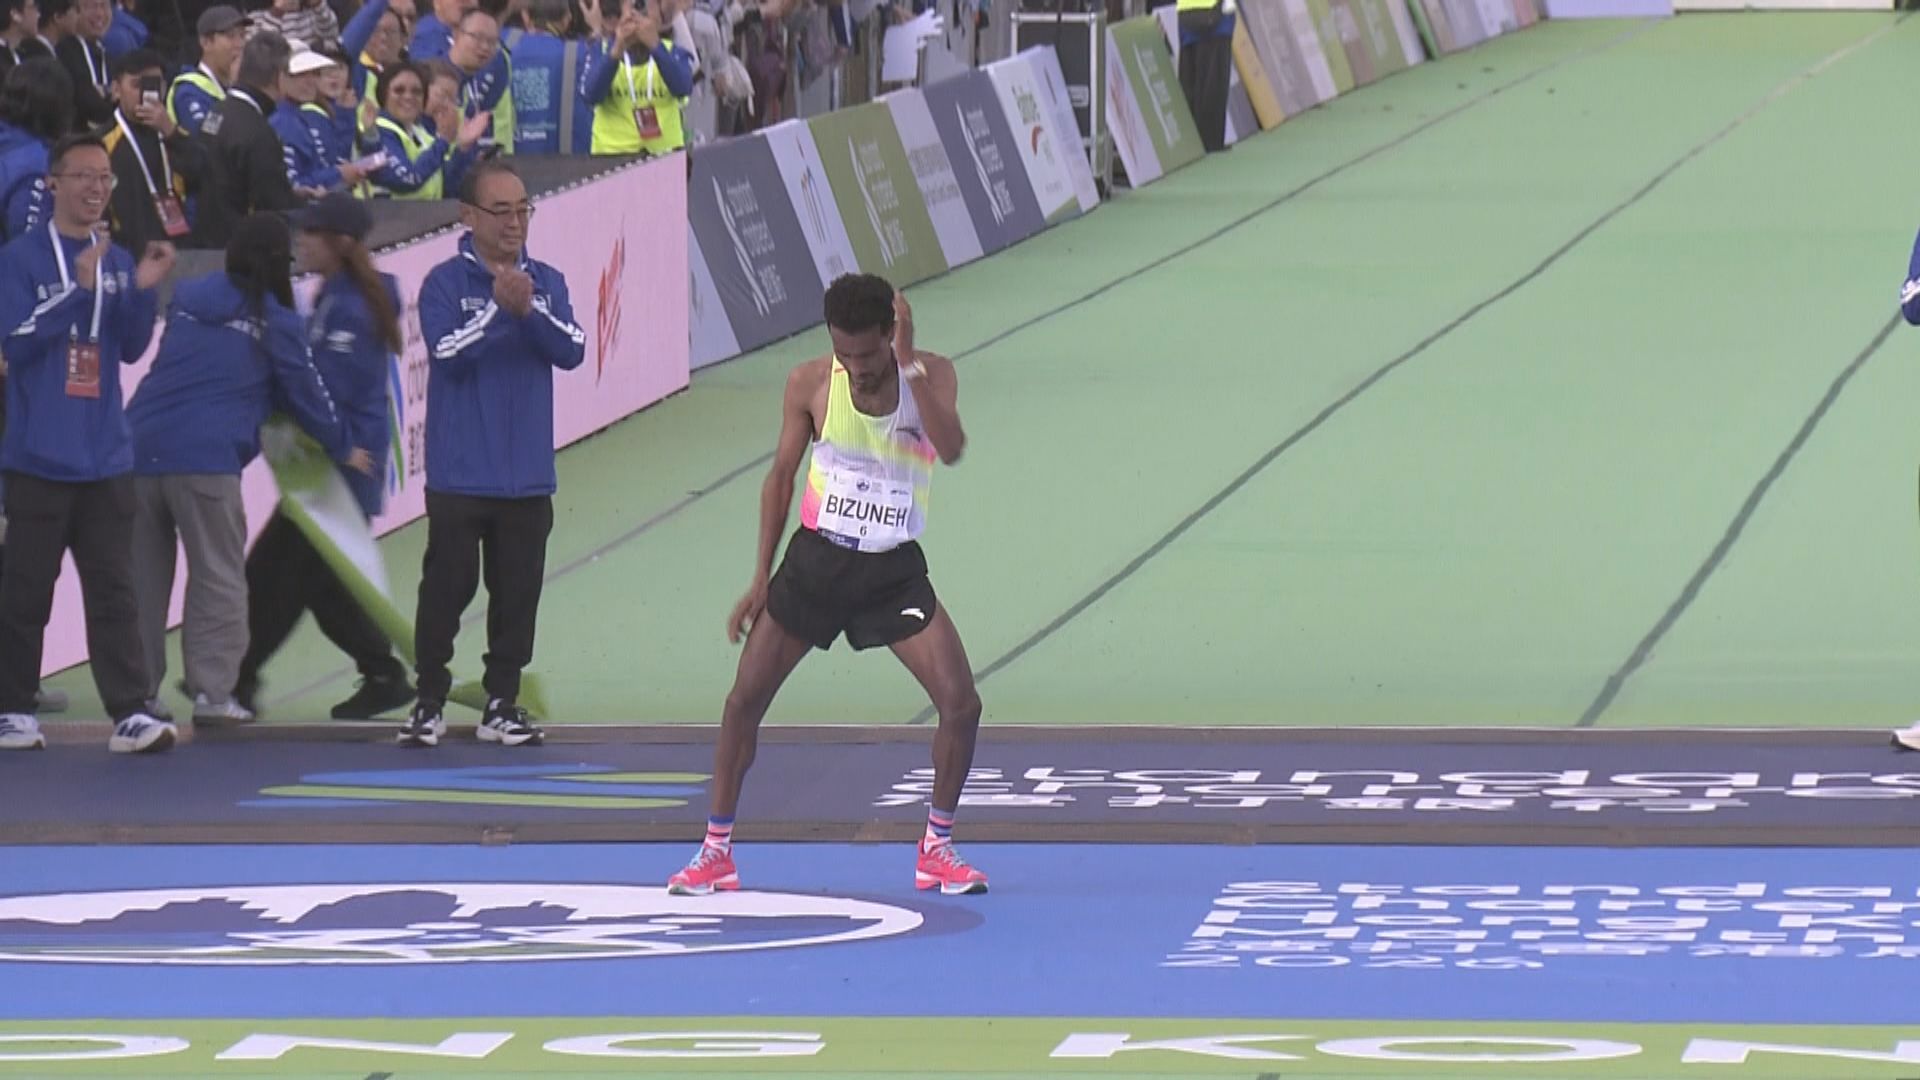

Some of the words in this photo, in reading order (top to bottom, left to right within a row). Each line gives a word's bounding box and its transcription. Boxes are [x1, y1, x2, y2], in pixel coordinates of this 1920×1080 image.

[825, 494, 908, 527] BIZUNEH
[859, 525, 868, 536] 6
[1222, 880, 1920, 898] Standa
[1203, 910, 1709, 930] Hong
[1778, 914, 1920, 929] K
[1157, 954, 1545, 969] 2026
